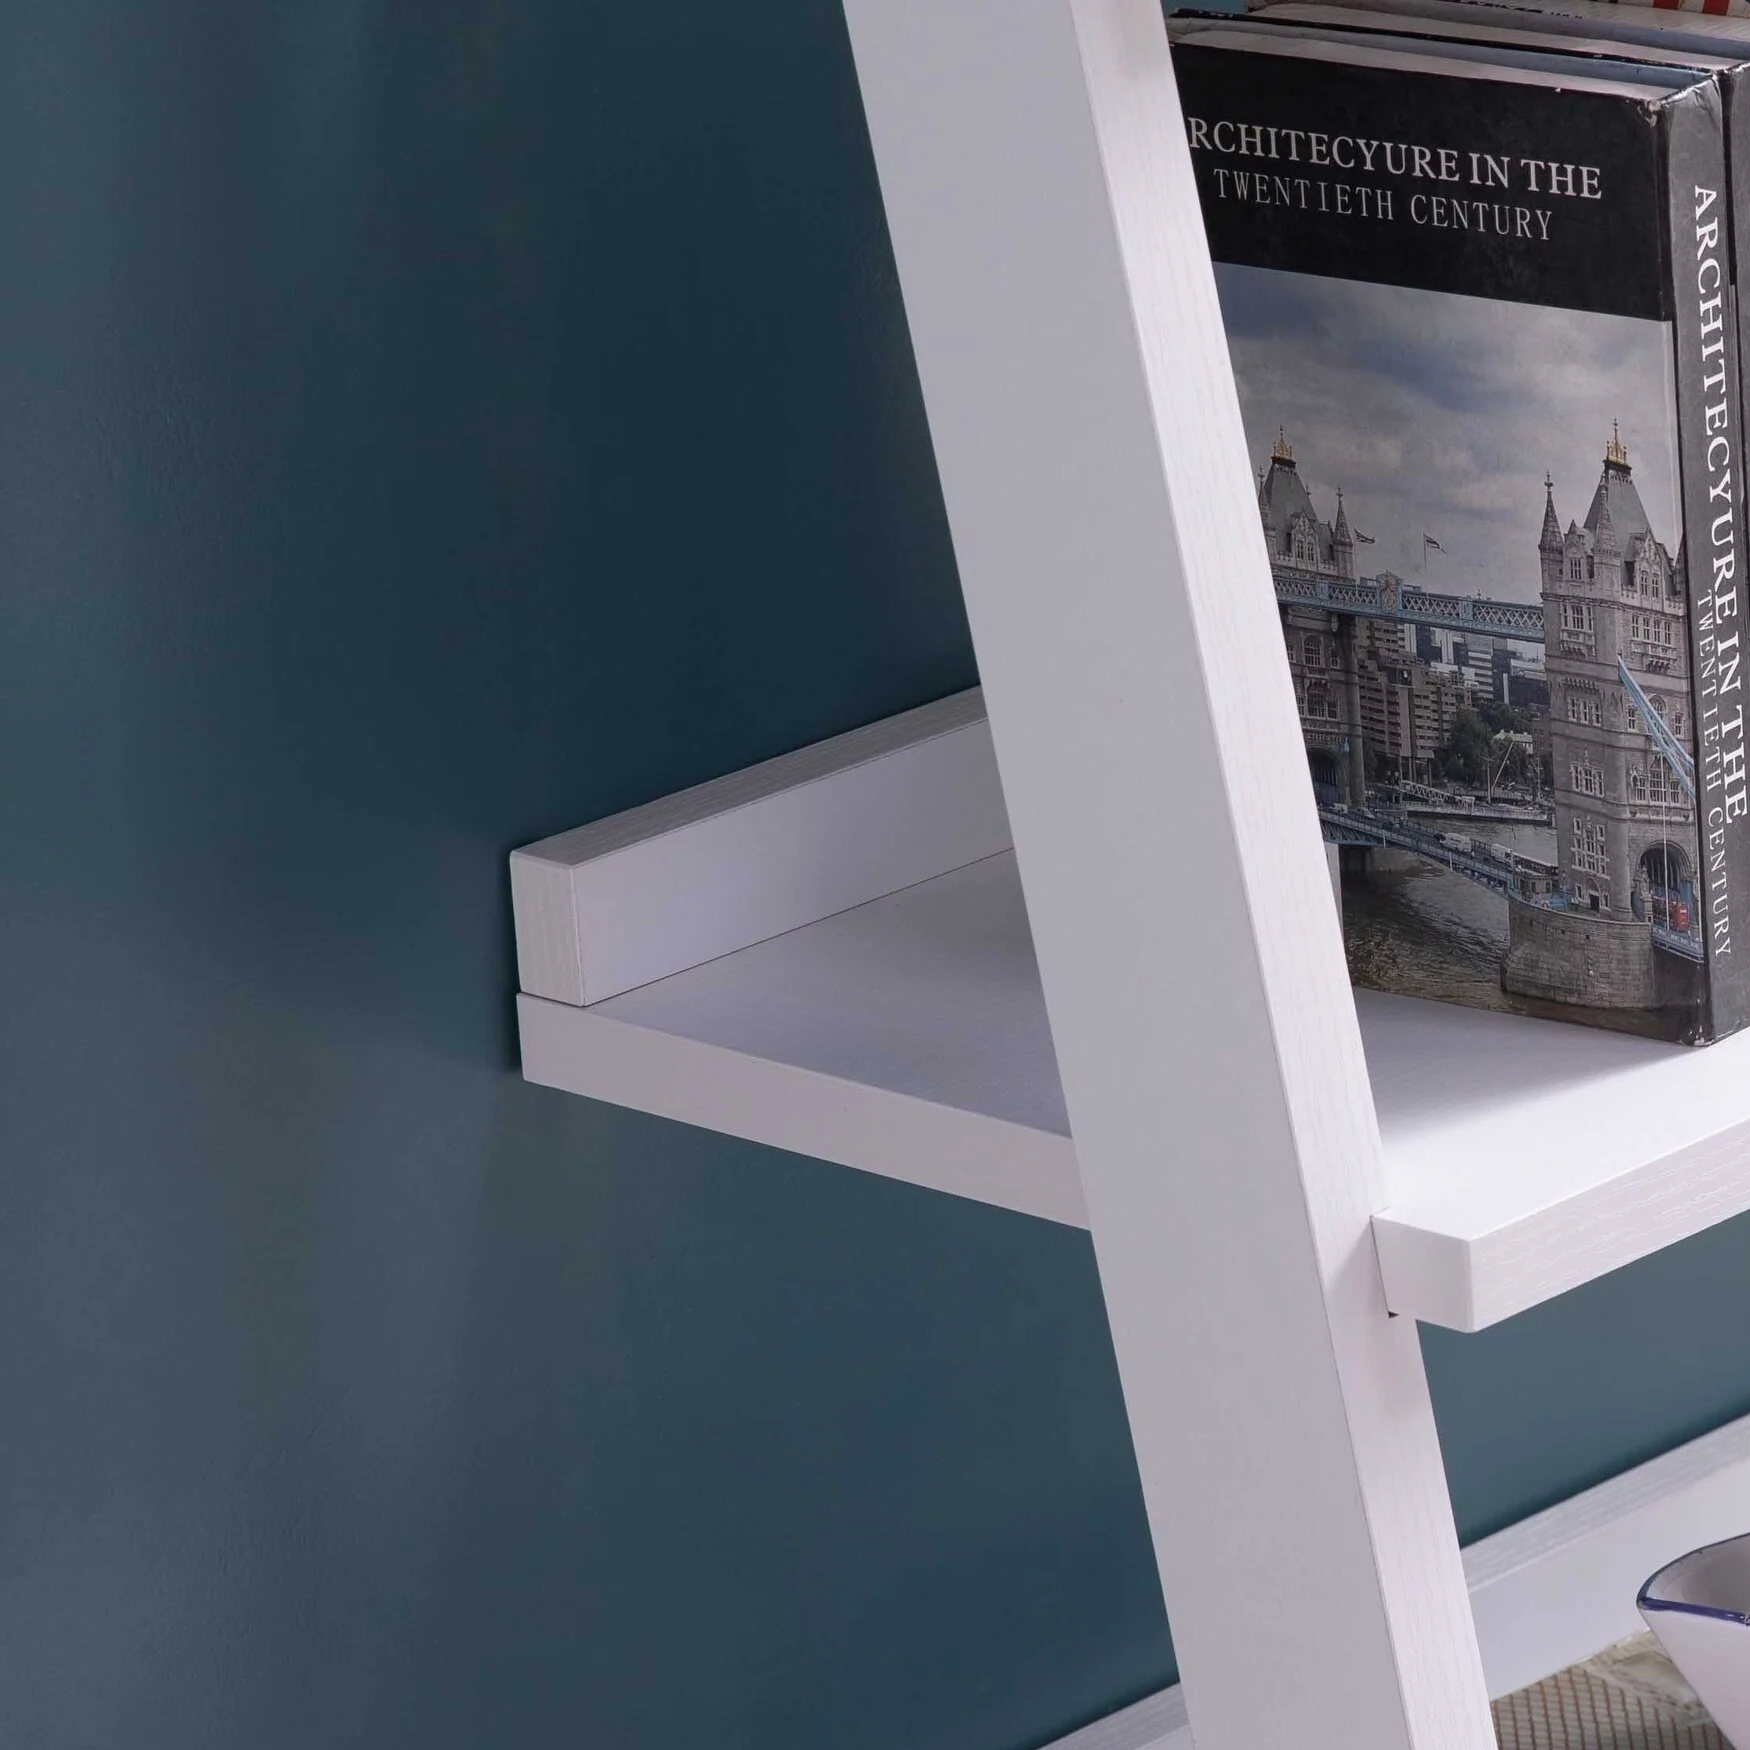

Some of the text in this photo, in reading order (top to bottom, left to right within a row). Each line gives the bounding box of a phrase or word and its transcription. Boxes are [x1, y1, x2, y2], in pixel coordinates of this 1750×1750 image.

[1188, 116, 1603, 199] RCHITECYURE IN THE
[1213, 168, 1553, 241] TWENTIETH CENTURY
[1694, 185, 1748, 824] ARCHITECYURE IN THE
[1697, 589, 1731, 957] TWENTIETH CENTURY
